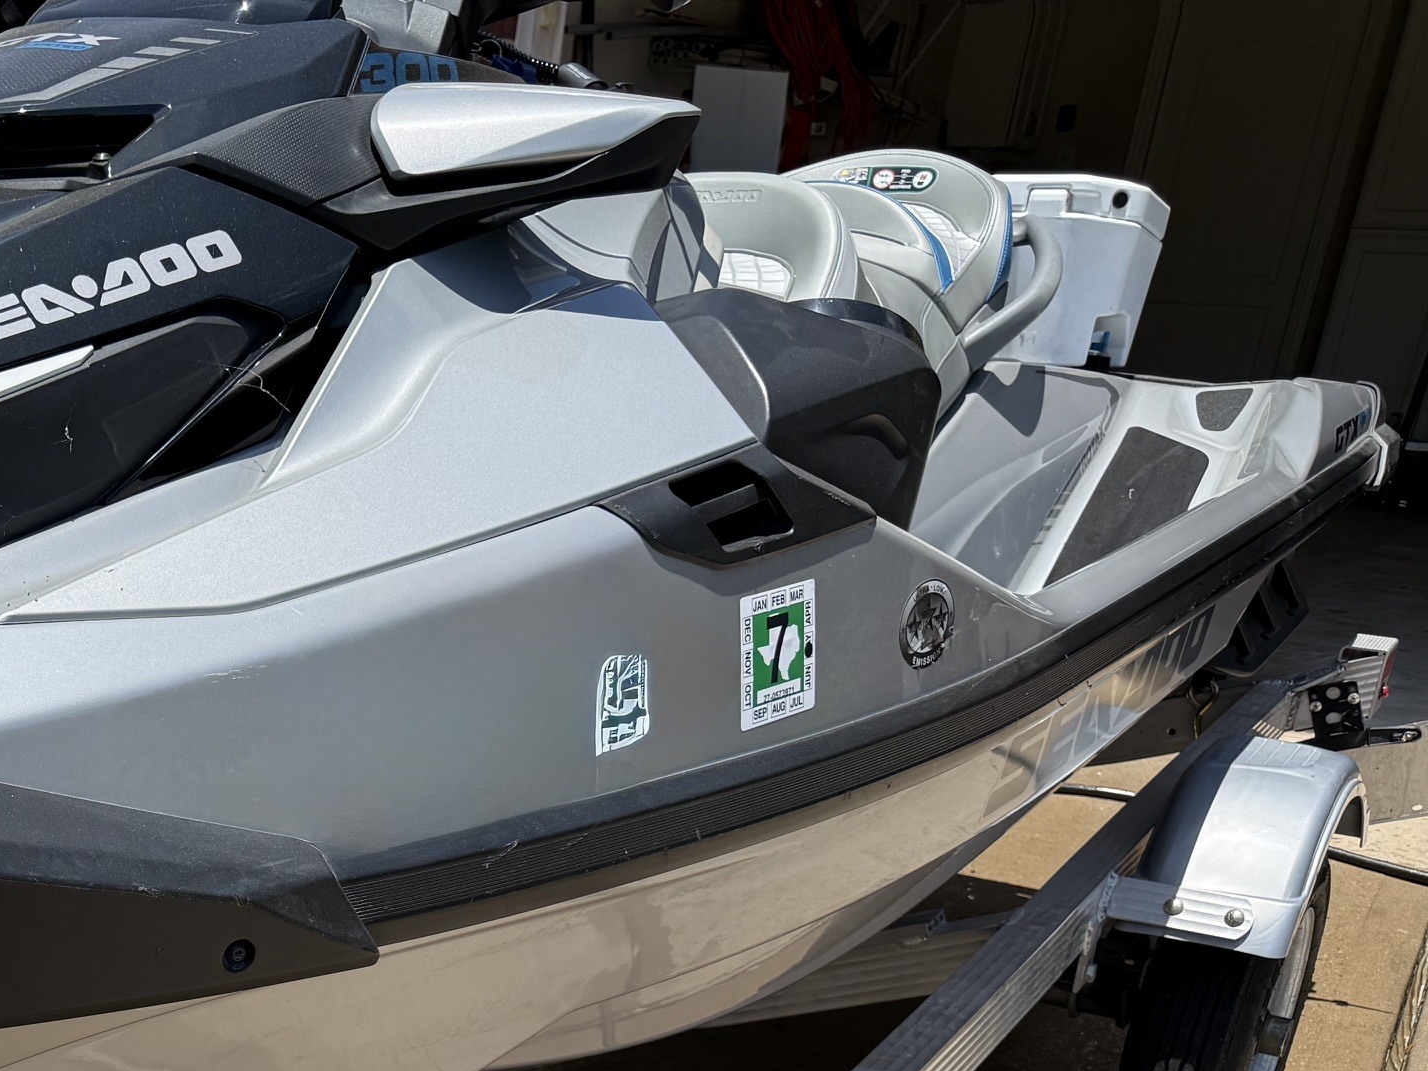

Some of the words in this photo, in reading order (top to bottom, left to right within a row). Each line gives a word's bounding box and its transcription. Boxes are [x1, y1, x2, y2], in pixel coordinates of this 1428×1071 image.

[360, 52, 460, 93] 300
[752, 600, 767, 612] JAN
[772, 594, 785, 605] FEB
[789, 588, 803, 600] MAR
[766, 612, 789, 683] 7
[753, 707, 767, 720] SEP
[772, 701, 785, 714] AUG
[790, 695, 803, 708] JUL
